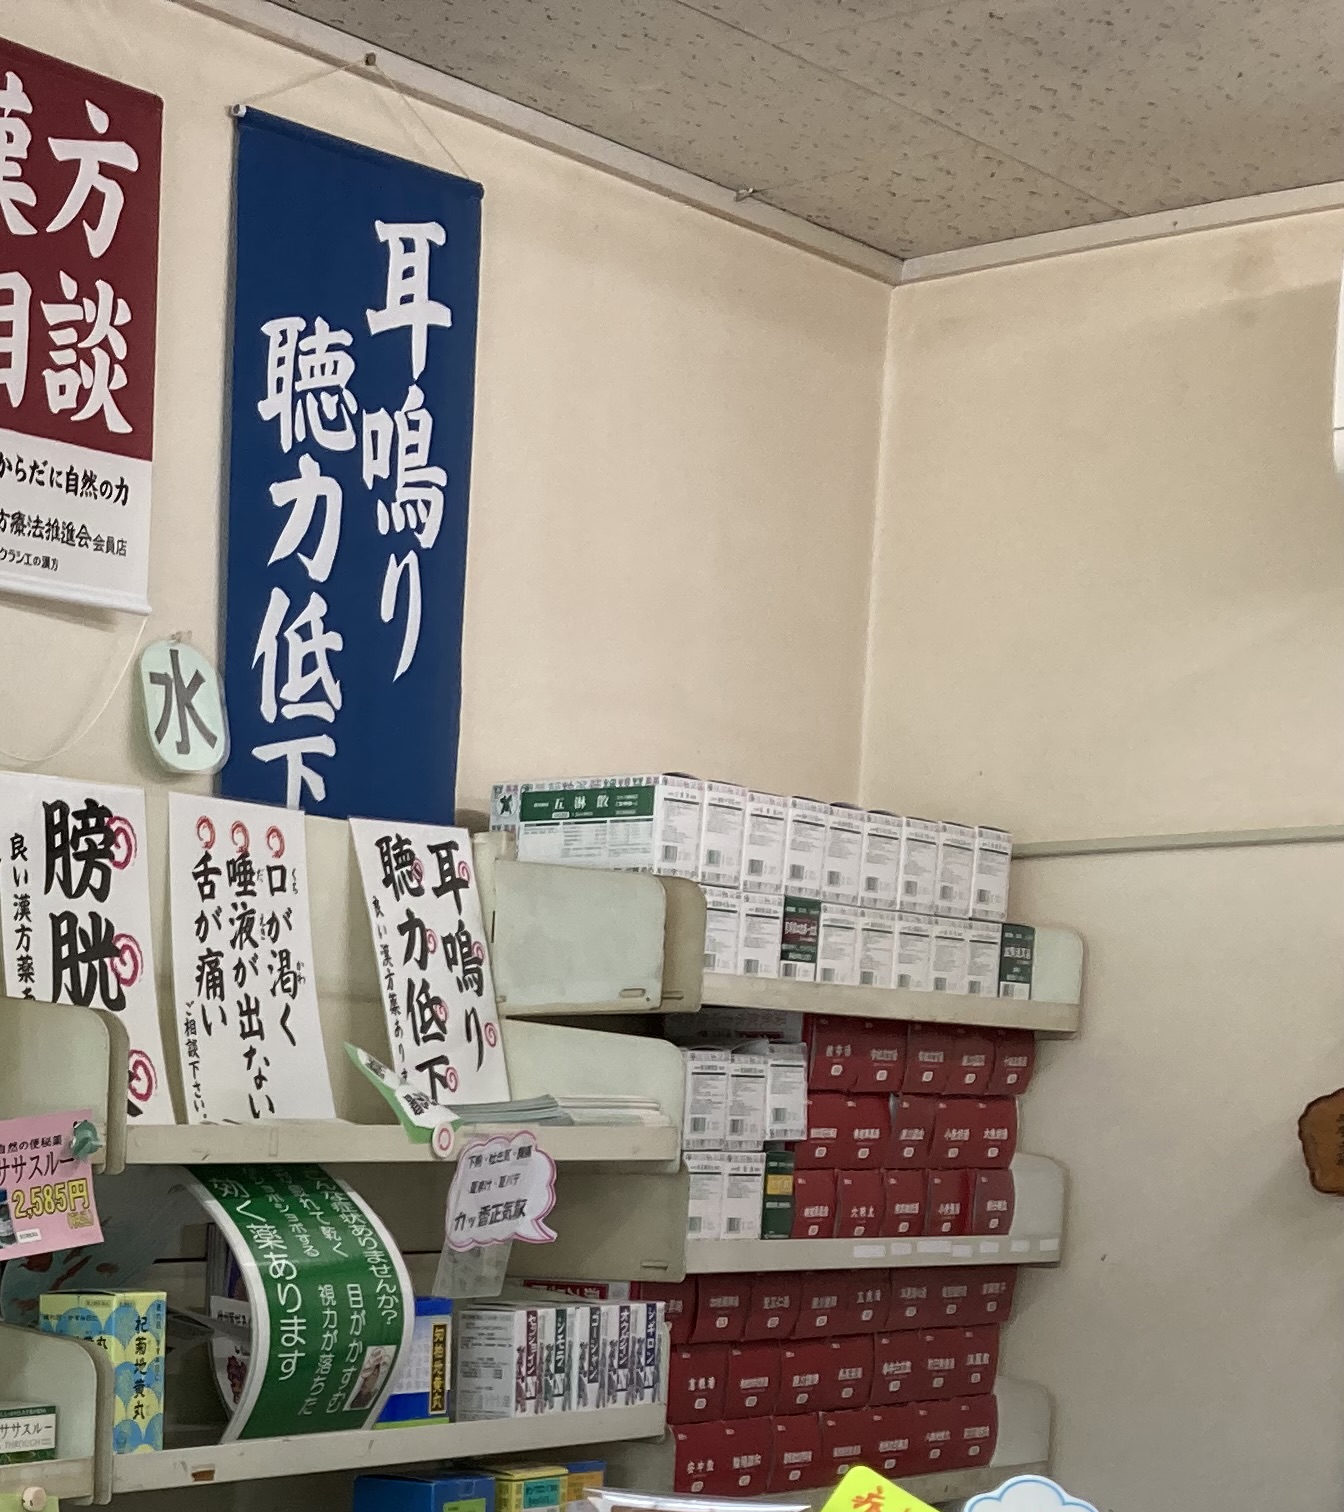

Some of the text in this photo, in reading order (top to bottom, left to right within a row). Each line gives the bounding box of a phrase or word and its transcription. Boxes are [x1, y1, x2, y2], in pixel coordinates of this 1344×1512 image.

[363, 219, 452, 681] 耳鳴り
[0, 546, 59, 571] クラシエの漢方
[251, 315, 358, 814] 聴力低下
[149, 651, 217, 756] 水
[43, 798, 126, 1012] 膀胱
[193, 853, 228, 1037] 舌が痛い
[228, 853, 278, 1119] 唾液が出ない
[265, 859, 298, 1048] 口が渇く
[374, 835, 456, 1103] 聴力低下
[424, 840, 487, 1073] 耳鳴り
[13, 1178, 90, 1219] 2,585円
[0, 1423, 53, 1438] ササスルー
[299, 1285, 337, 1415] 視力が落ちた
[327, 1284, 366, 1414] 目がかすむ
